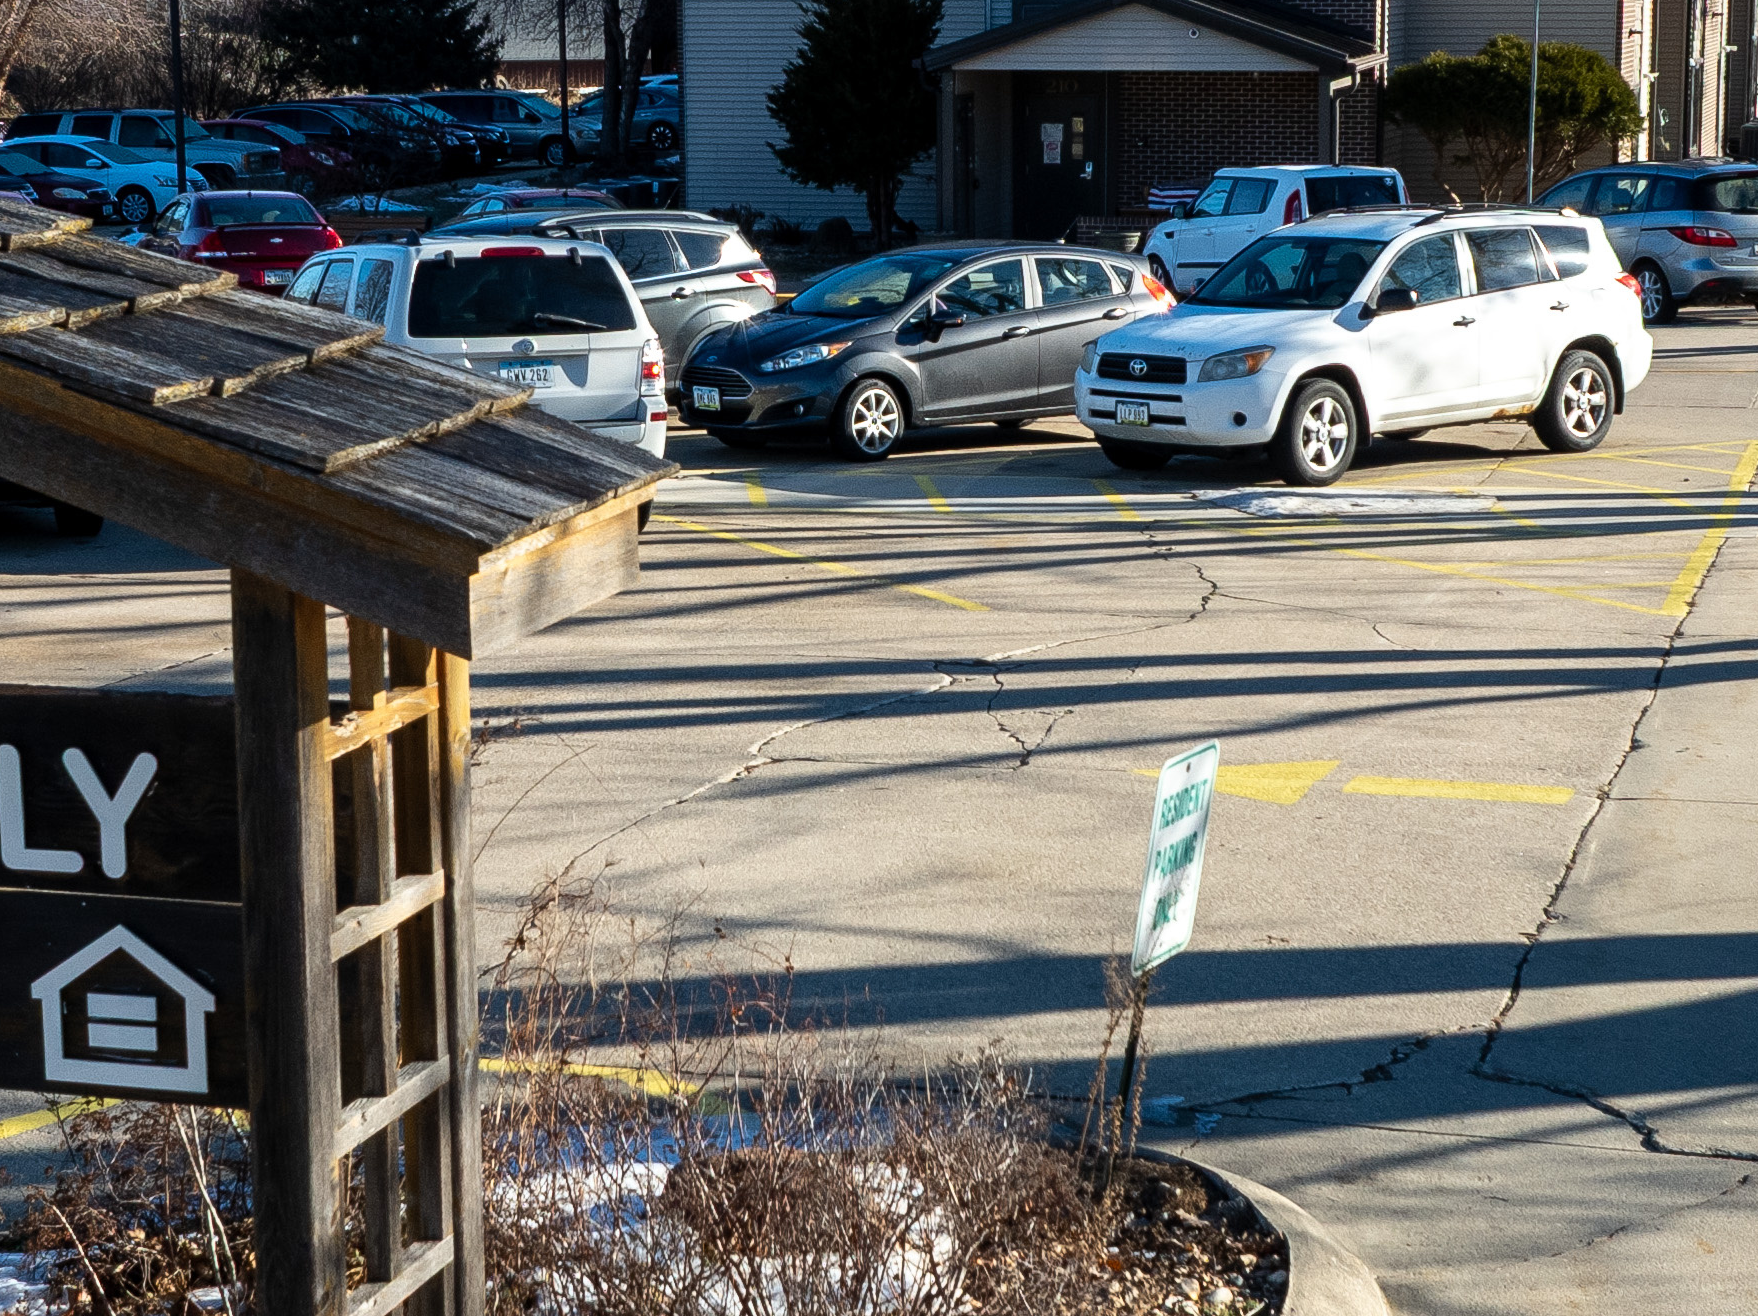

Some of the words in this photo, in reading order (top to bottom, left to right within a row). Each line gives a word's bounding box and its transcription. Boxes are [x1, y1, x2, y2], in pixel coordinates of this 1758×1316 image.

[530, 368, 548, 381] 262
[1159, 778, 1208, 830] RESIDENT
[1153, 831, 1198, 881] PARKING
